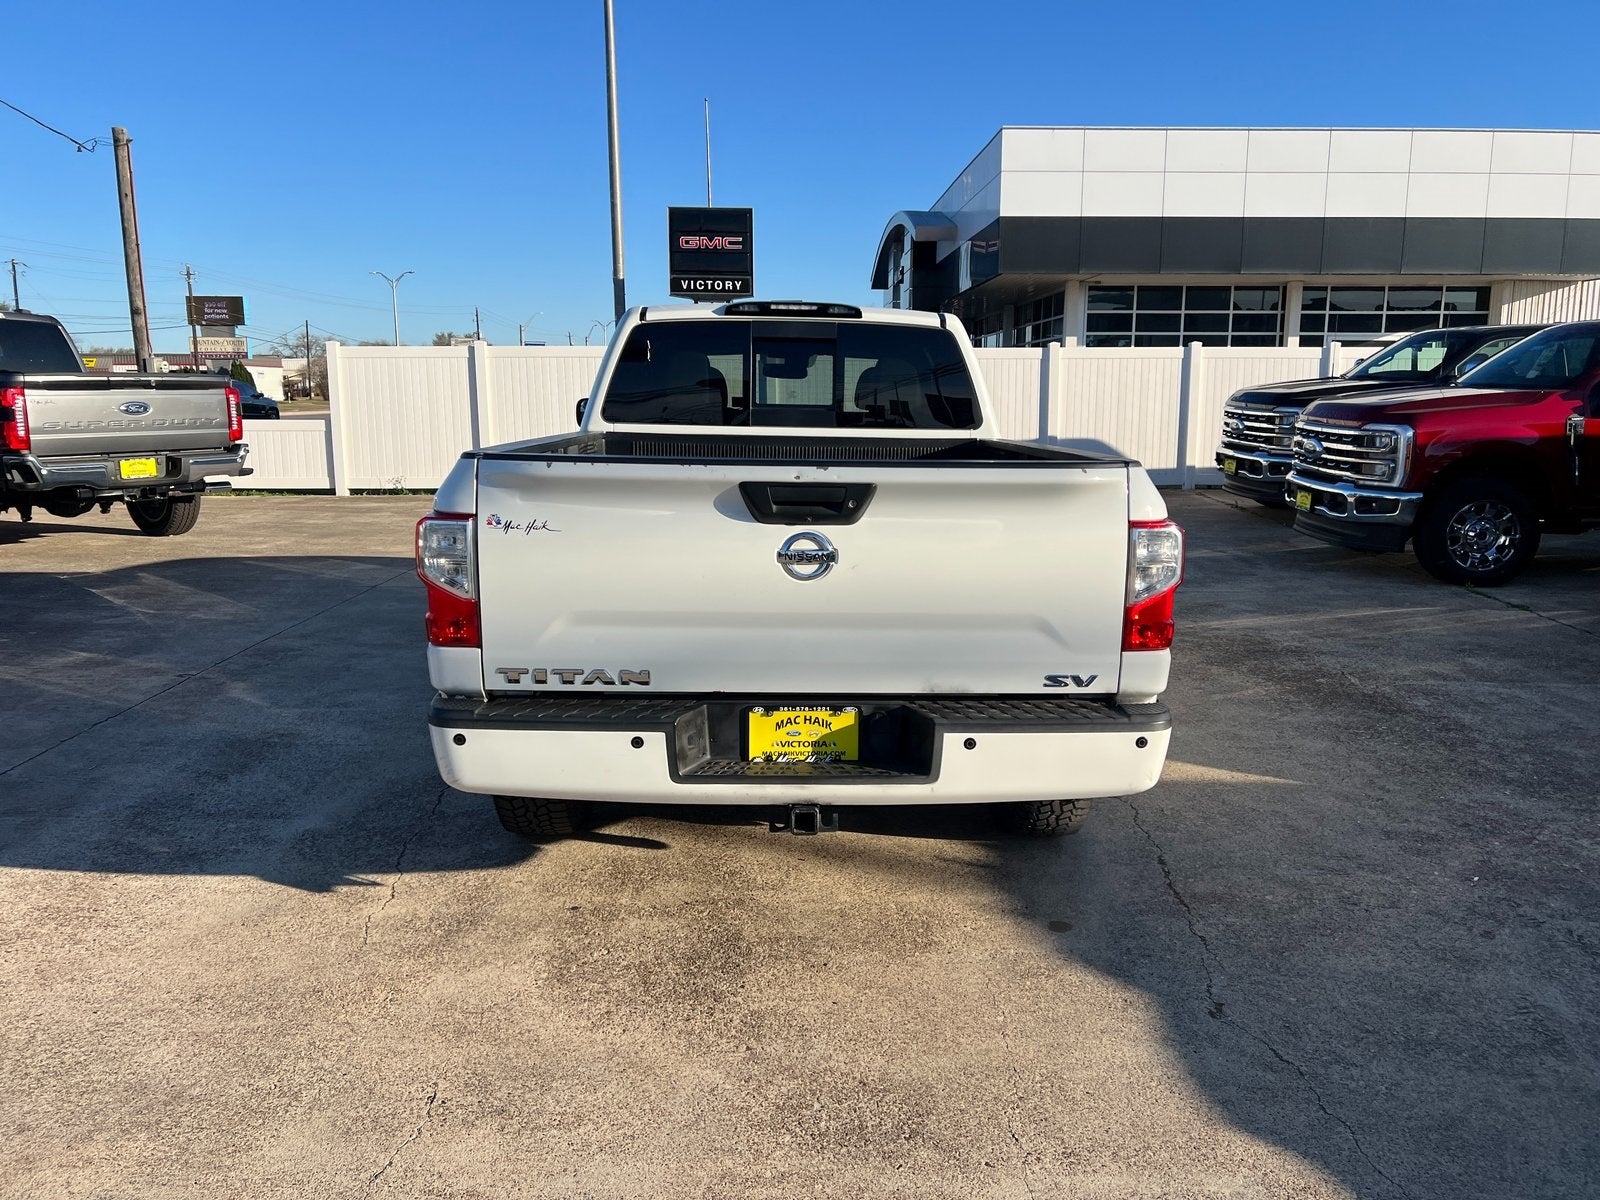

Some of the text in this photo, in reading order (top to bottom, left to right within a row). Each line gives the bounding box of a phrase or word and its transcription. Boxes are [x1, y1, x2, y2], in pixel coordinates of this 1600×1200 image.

[679, 236, 743, 249] GMC
[681, 279, 742, 290] VICTORY
[42, 417, 220, 431] SUPER DUTY
[502, 518, 562, 536] Mac Haik
[784, 552, 830, 562] NISSAN
[495, 667, 651, 686] TITAN
[1042, 674, 1099, 688] SV
[775, 715, 832, 732] MAC HAIK
[780, 740, 829, 748] VICTORIA
